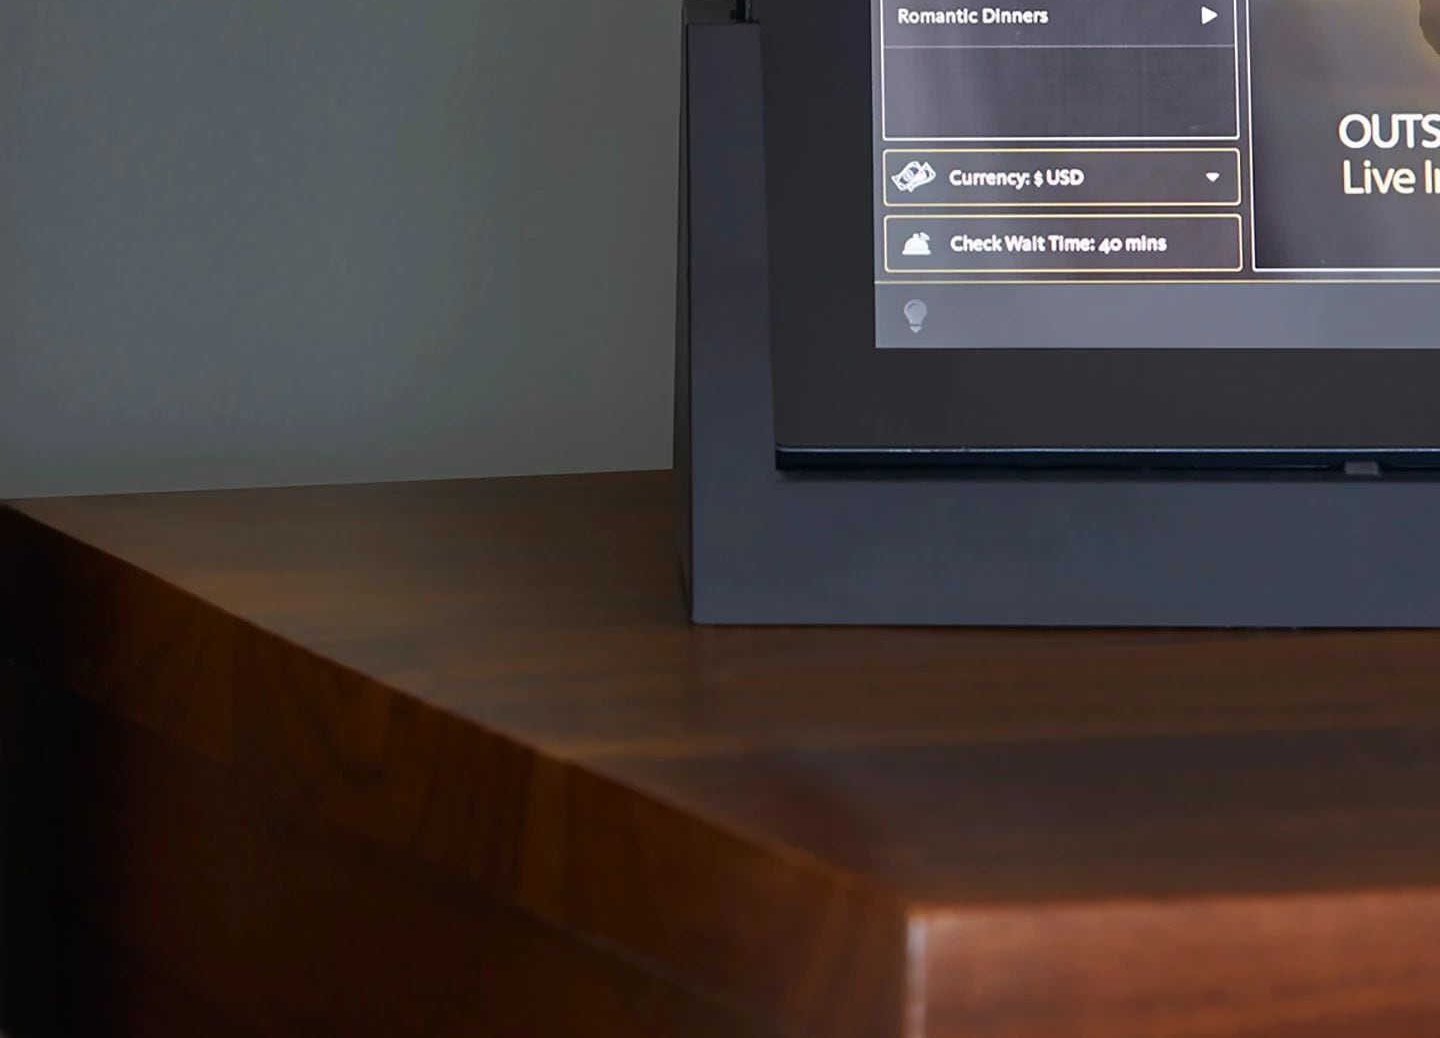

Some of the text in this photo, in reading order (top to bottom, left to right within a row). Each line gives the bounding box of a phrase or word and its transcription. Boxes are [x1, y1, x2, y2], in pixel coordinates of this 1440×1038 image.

[897, 8, 1049, 24] Romantic Dinners
[949, 169, 1085, 189] Currency: $ USD
[1342, 160, 1416, 195] Live
[950, 234, 1168, 255] Check Wait Time: 40 mins
